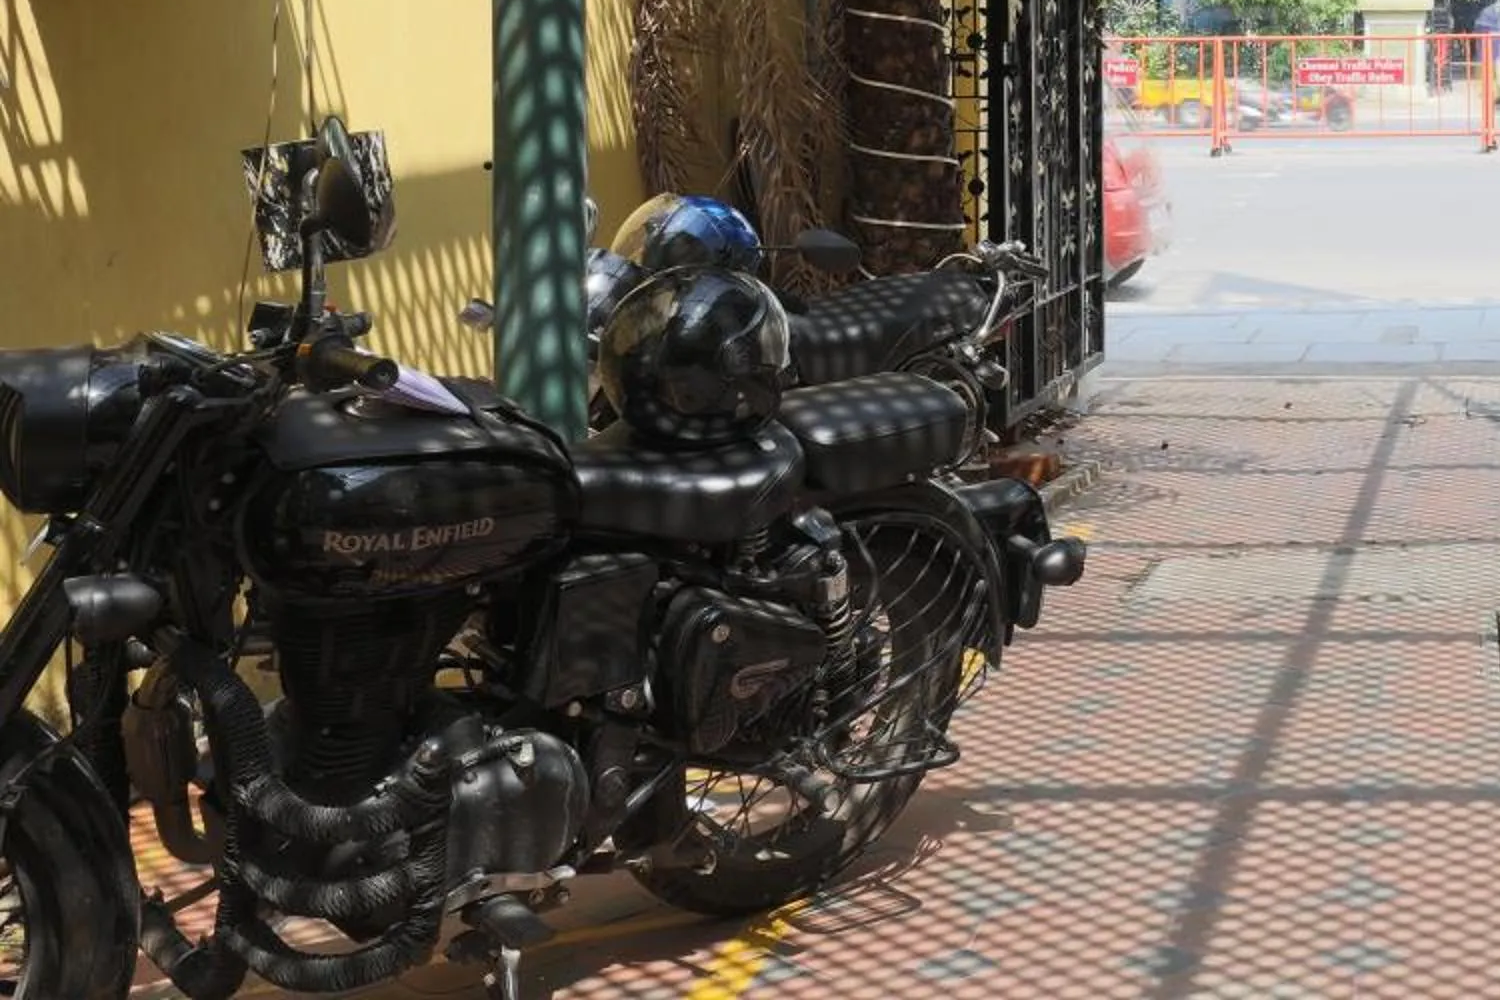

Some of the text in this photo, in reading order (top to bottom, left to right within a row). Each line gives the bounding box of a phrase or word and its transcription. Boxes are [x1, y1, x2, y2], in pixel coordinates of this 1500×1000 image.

[1340, 58, 1371, 70] Traffic
[1374, 58, 1403, 70] Police
[1335, 71, 1365, 83] Traffic
[323, 517, 496, 553] ROYAL ENFIELD
